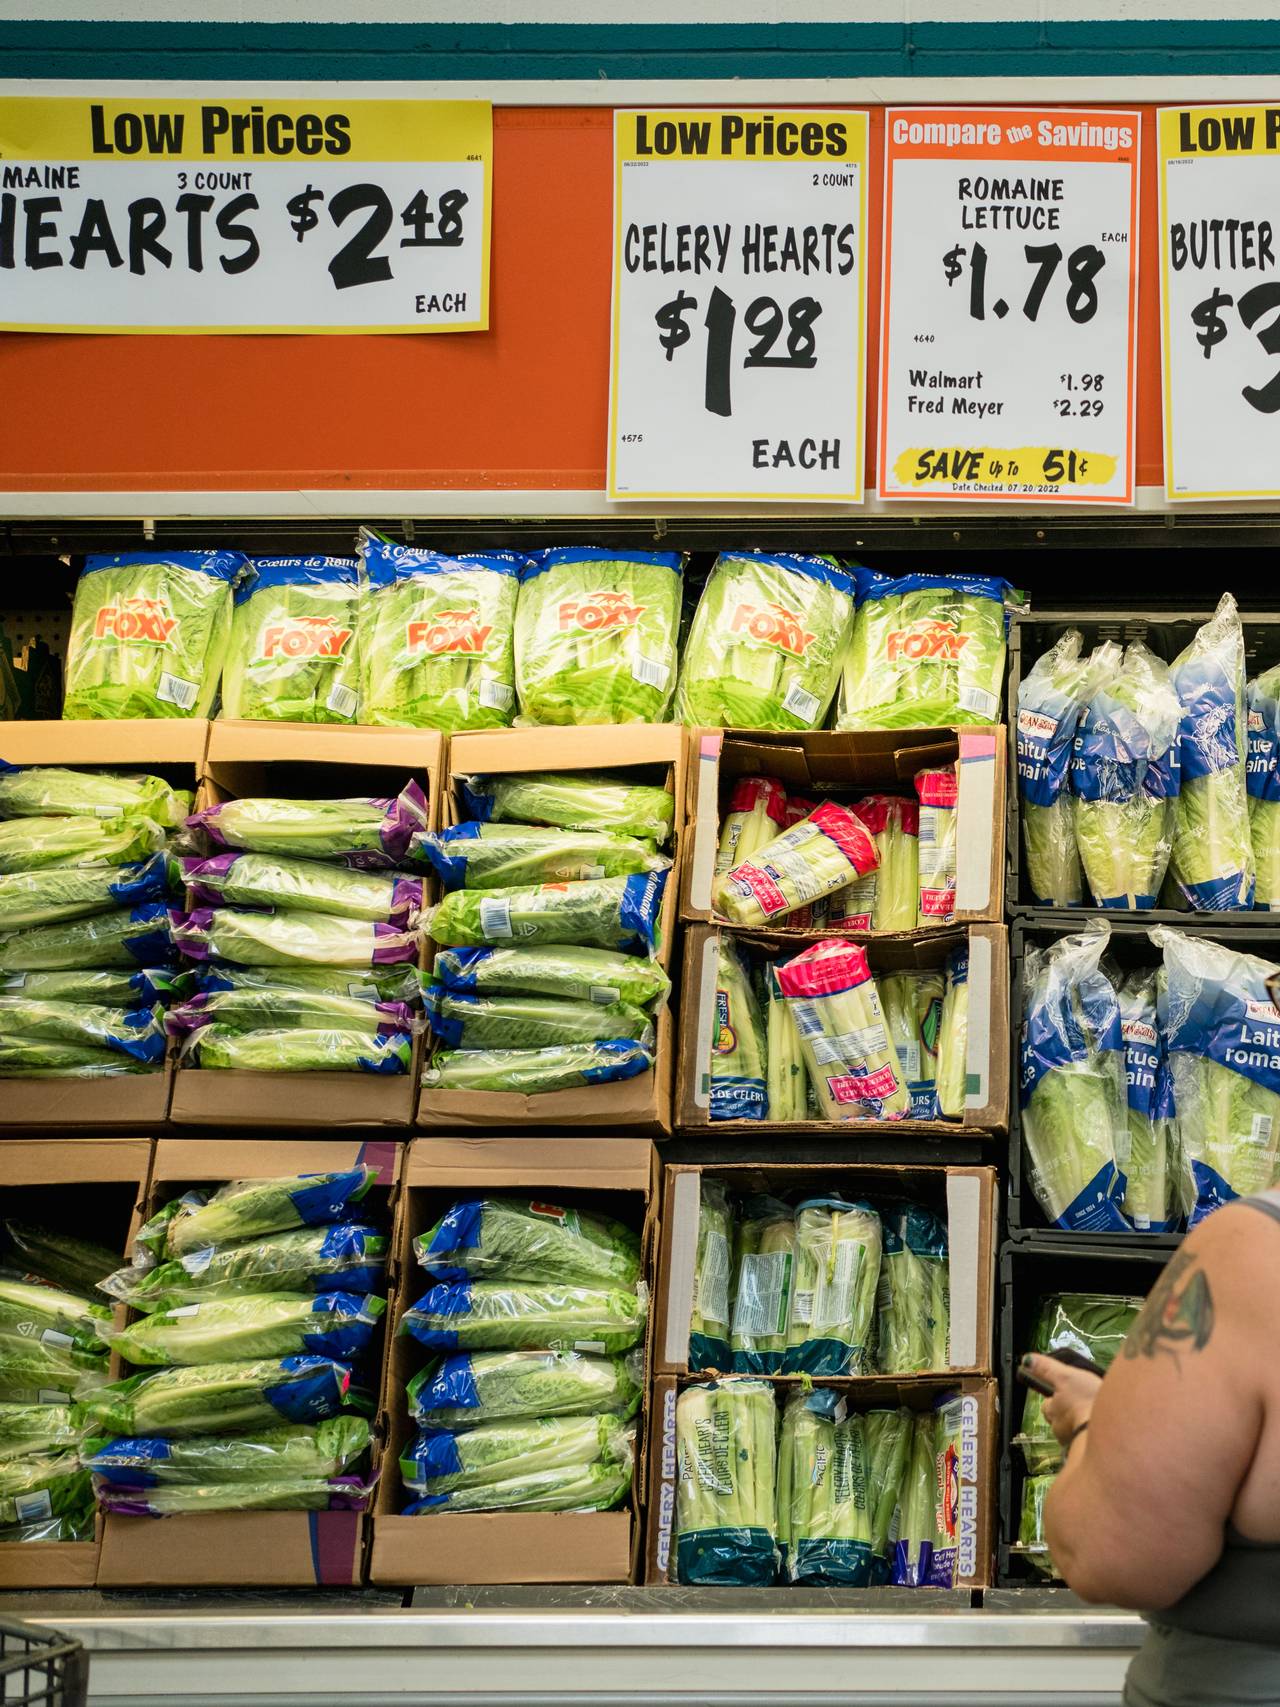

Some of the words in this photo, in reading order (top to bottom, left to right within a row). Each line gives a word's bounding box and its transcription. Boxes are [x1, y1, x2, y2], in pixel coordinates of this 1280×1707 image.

[91, 105, 184, 154] Low
[202, 106, 351, 155] Prices
[637, 116, 711, 155] Low
[722, 116, 847, 156] Prices
[893, 119, 1001, 147] Compare
[1005, 124, 1033, 144] the
[1037, 121, 1133, 150] Savings
[1180, 113, 1255, 152] Low
[178, 173, 187, 189] 3
[195, 173, 252, 190] COUNT
[813, 174, 818, 185] 2
[823, 174, 854, 186] COUNT
[959, 177, 1063, 201] ROMAINE
[962, 205, 1059, 230] LETTUCE
[625, 222, 731, 274] CELERY
[742, 224, 854, 275] HEARTS
[1102, 233, 1127, 242] EACH
[1171, 219, 1274, 271] BUTTER
[943, 240, 1106, 324] $1.78
[416, 293, 466, 313] EACH
[909, 370, 983, 388] Walmart
[1061, 374, 1104, 391] $1.98
[908, 396, 943, 413] Fred
[952, 398, 1003, 419] Meyer
[1053, 400, 1103, 417] $2.29
[753, 438, 840, 470] EACH
[916, 450, 984, 480] SAVE
[990, 461, 1003, 478] Up
[1008, 461, 1018, 475] To
[1043, 450, 1088, 482] 51¢
[974, 483, 1002, 491] Checked
[1006, 483, 1060, 493] 07/20/2022
[95, 608, 179, 642] FOXY
[559, 602, 648, 631] FOXY
[730, 603, 818, 656] FOXY
[263, 626, 353, 659] FOXY
[407, 622, 494, 656] FOXY
[887, 631, 970, 661] FOXY
[962, 1400, 974, 1480] CELERY
[960, 1489, 973, 1575] HEARTS
